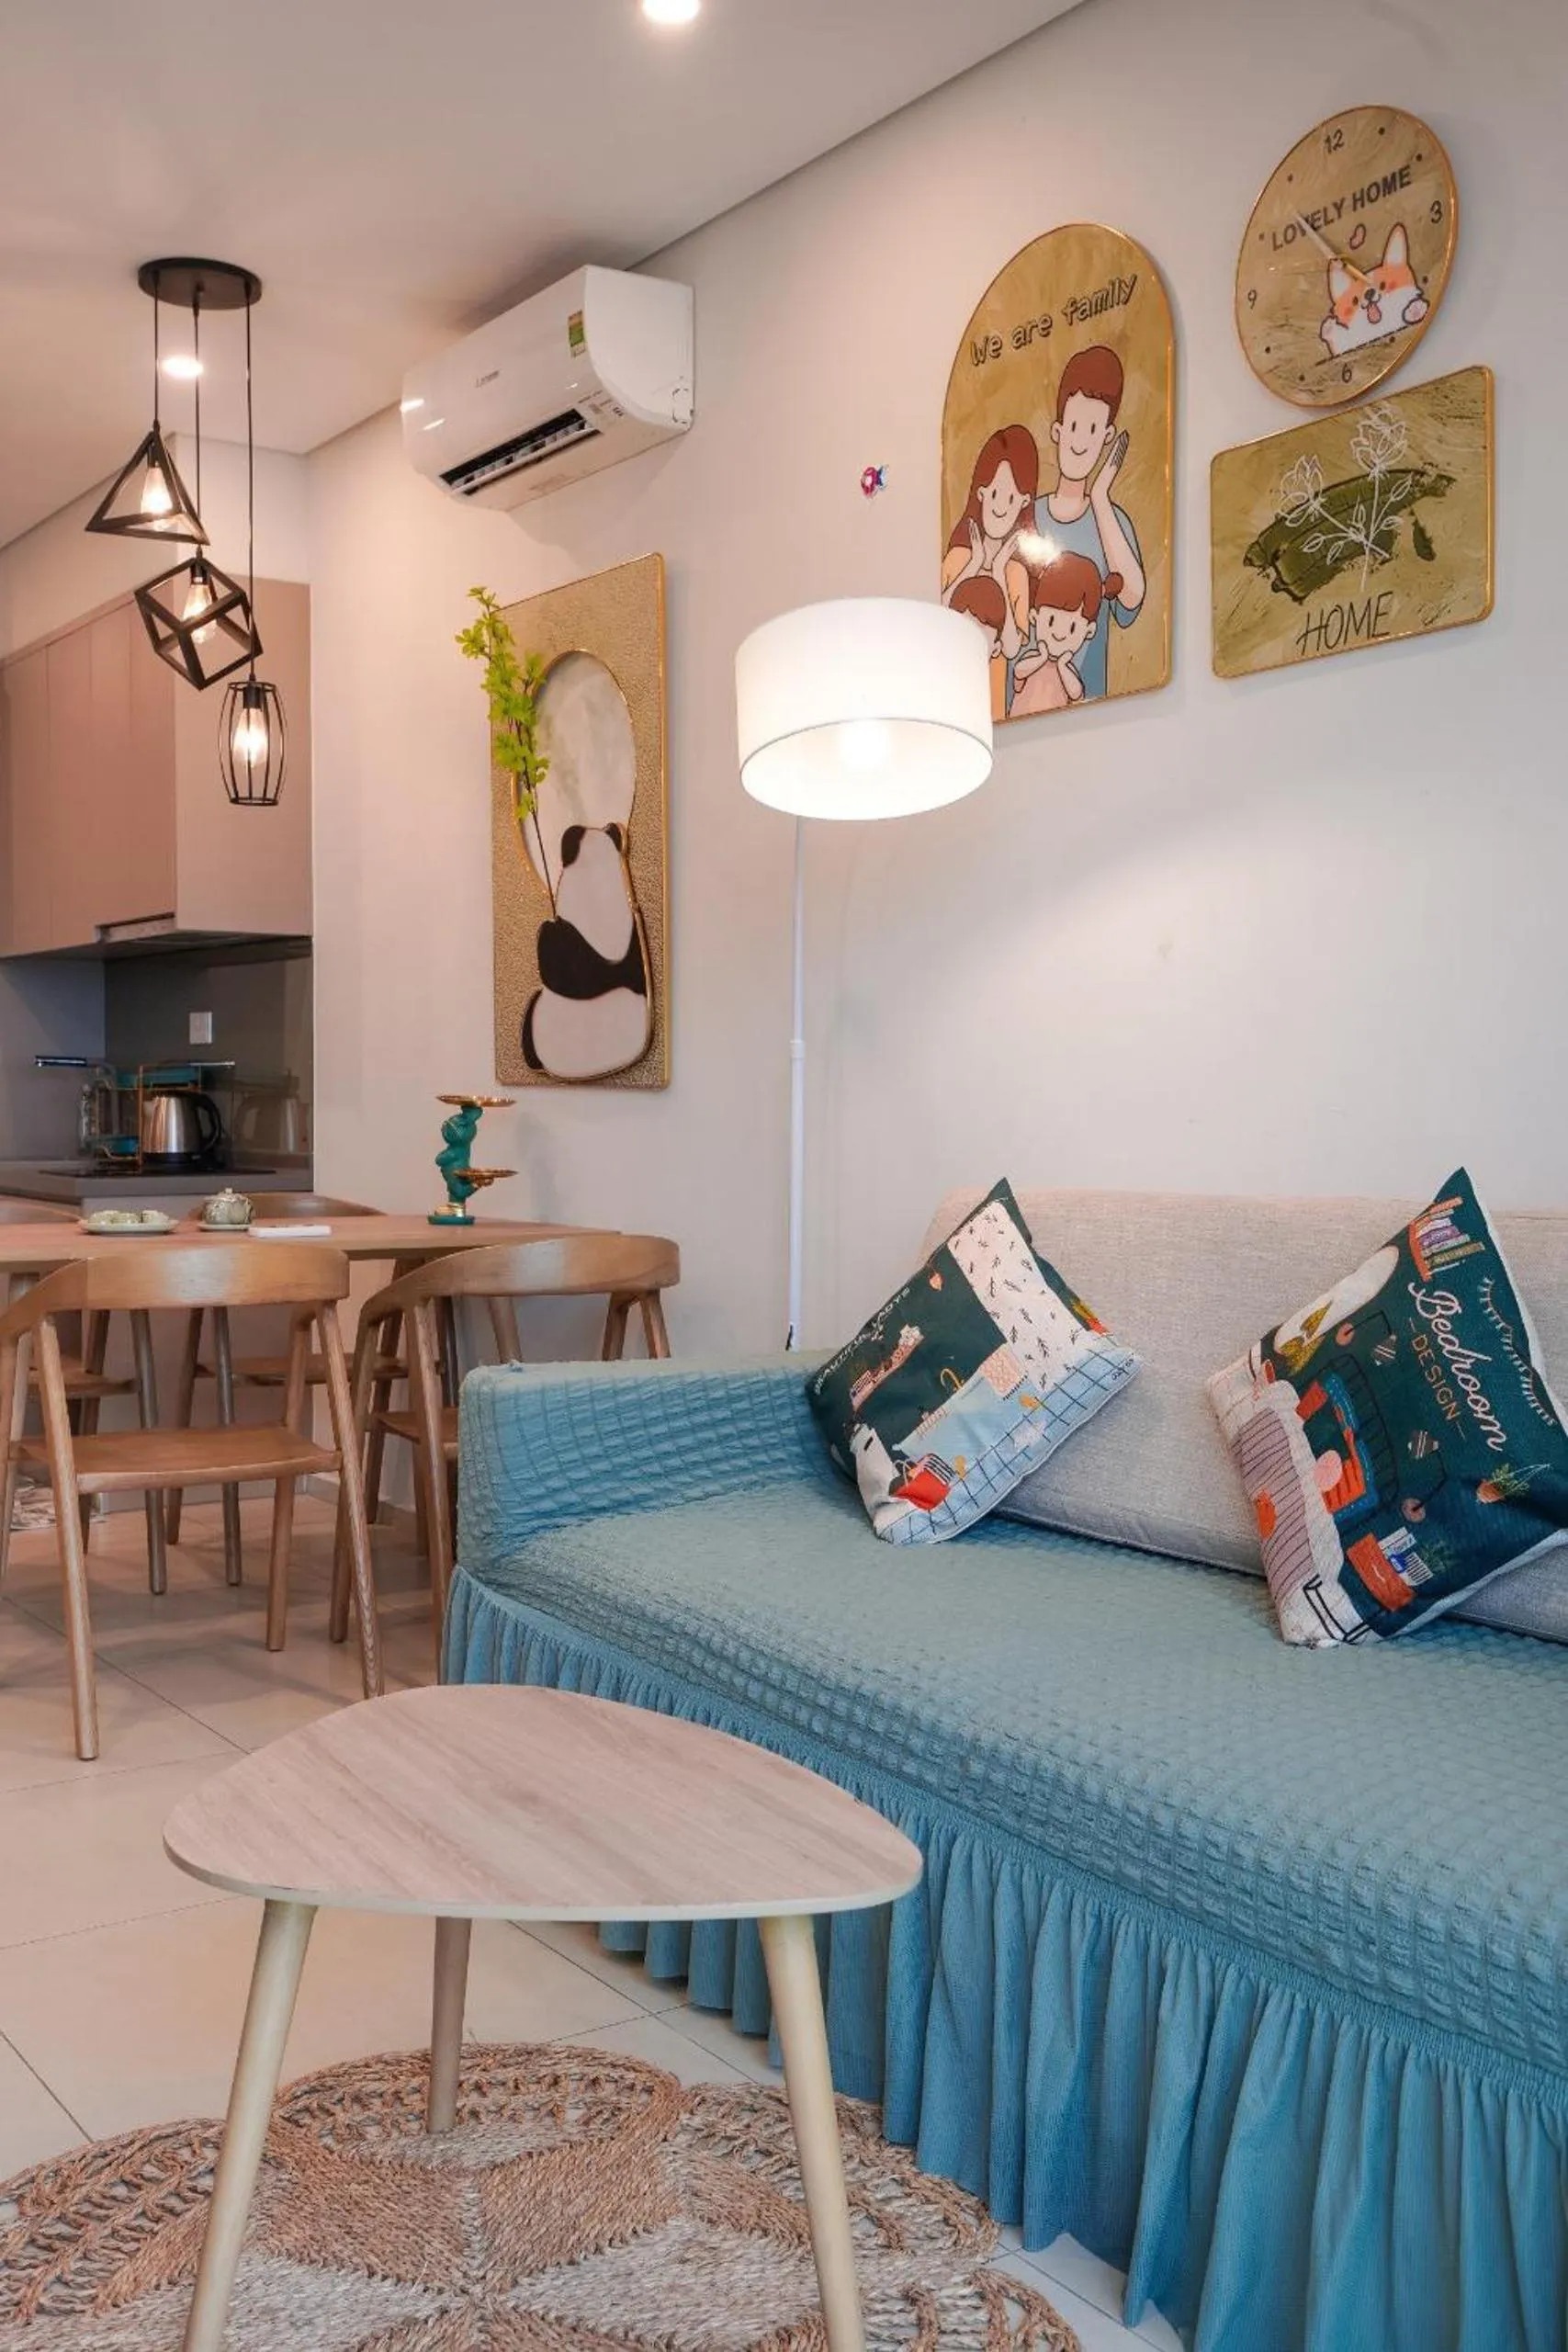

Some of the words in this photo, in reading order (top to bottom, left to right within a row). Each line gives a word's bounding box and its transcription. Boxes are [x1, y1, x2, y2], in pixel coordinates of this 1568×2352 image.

[1325, 129, 1345, 154] 12
[1271, 197, 1346, 251] LOVELY
[1351, 164, 1413, 212] HOME
[1429, 199, 1443, 223] 3
[970, 334, 1003, 367] We
[1012, 313, 1054, 351] are
[1062, 275, 1138, 326] family
[1247, 288, 1258, 310] 9
[1341, 363, 1353, 382] 6
[1296, 591, 1393, 655] HOME
[1407, 1283, 1506, 1452] Bedroom
[1412, 1334, 1461, 1420] DESIGN
